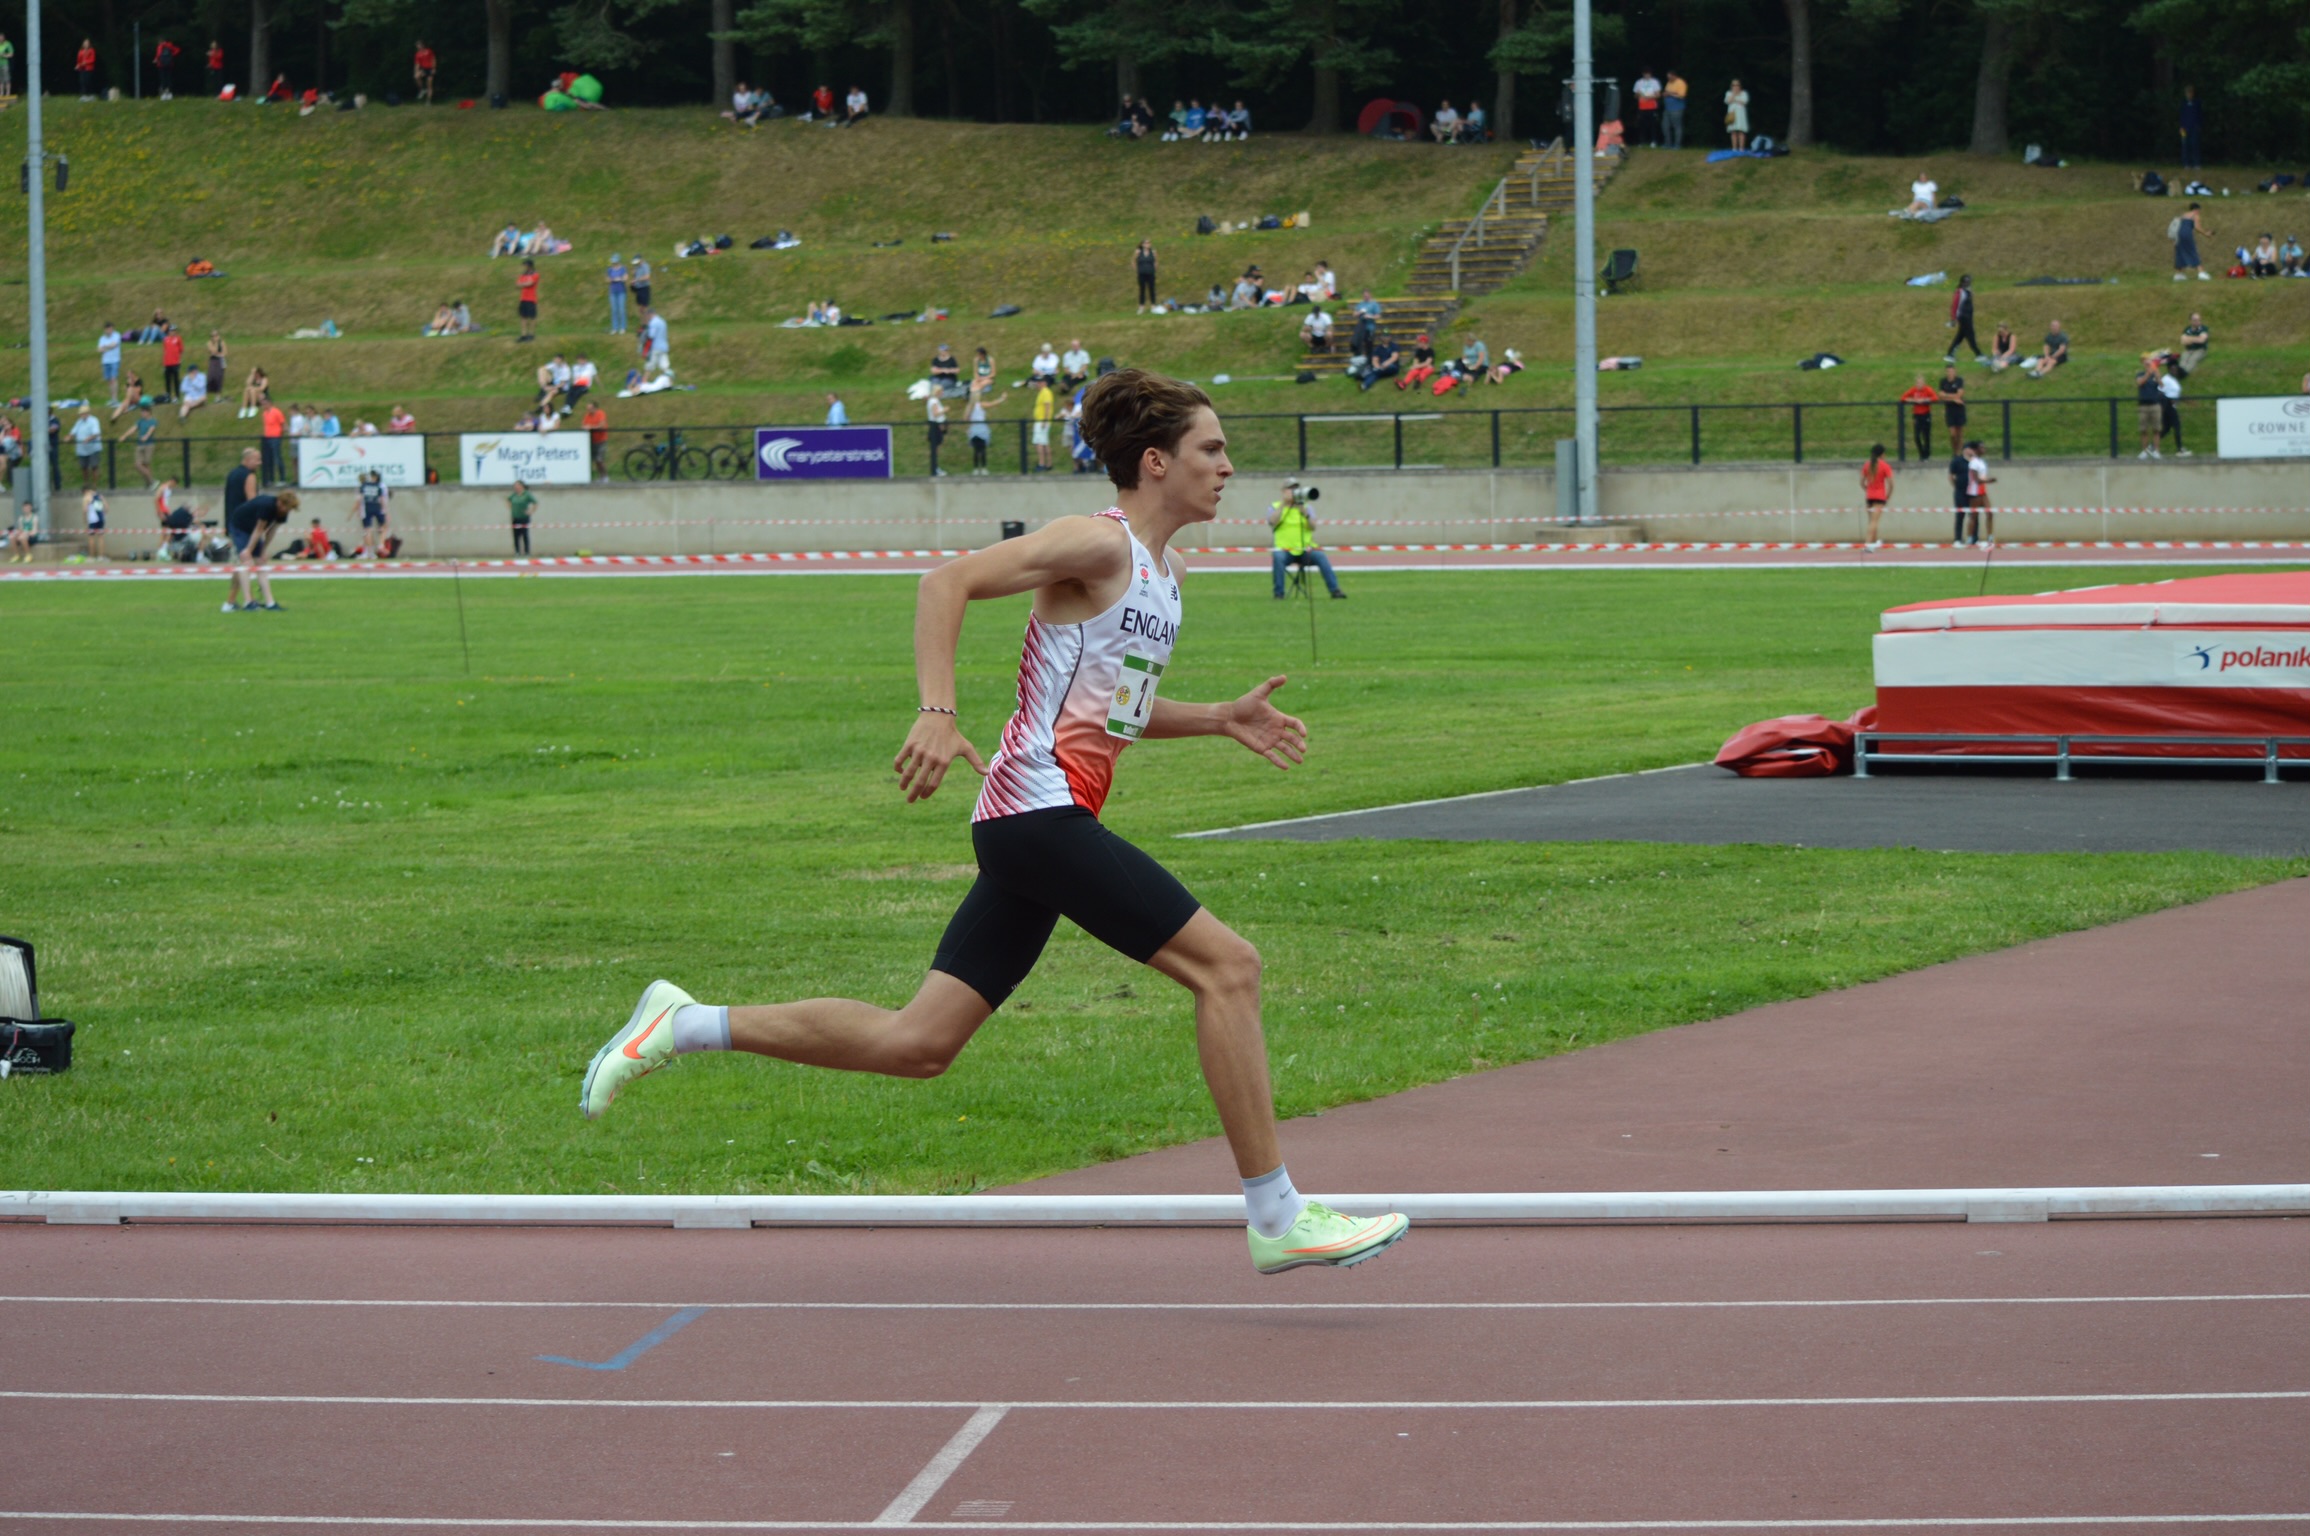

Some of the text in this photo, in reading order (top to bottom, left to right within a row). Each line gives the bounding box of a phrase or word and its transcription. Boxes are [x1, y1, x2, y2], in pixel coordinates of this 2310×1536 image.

[2248, 421, 2305, 435] CROWNE
[497, 445, 580, 465] Mary Peters
[512, 464, 547, 480] Trust
[1119, 607, 1180, 647] ENGLAN
[2219, 645, 2310, 672] polanik
